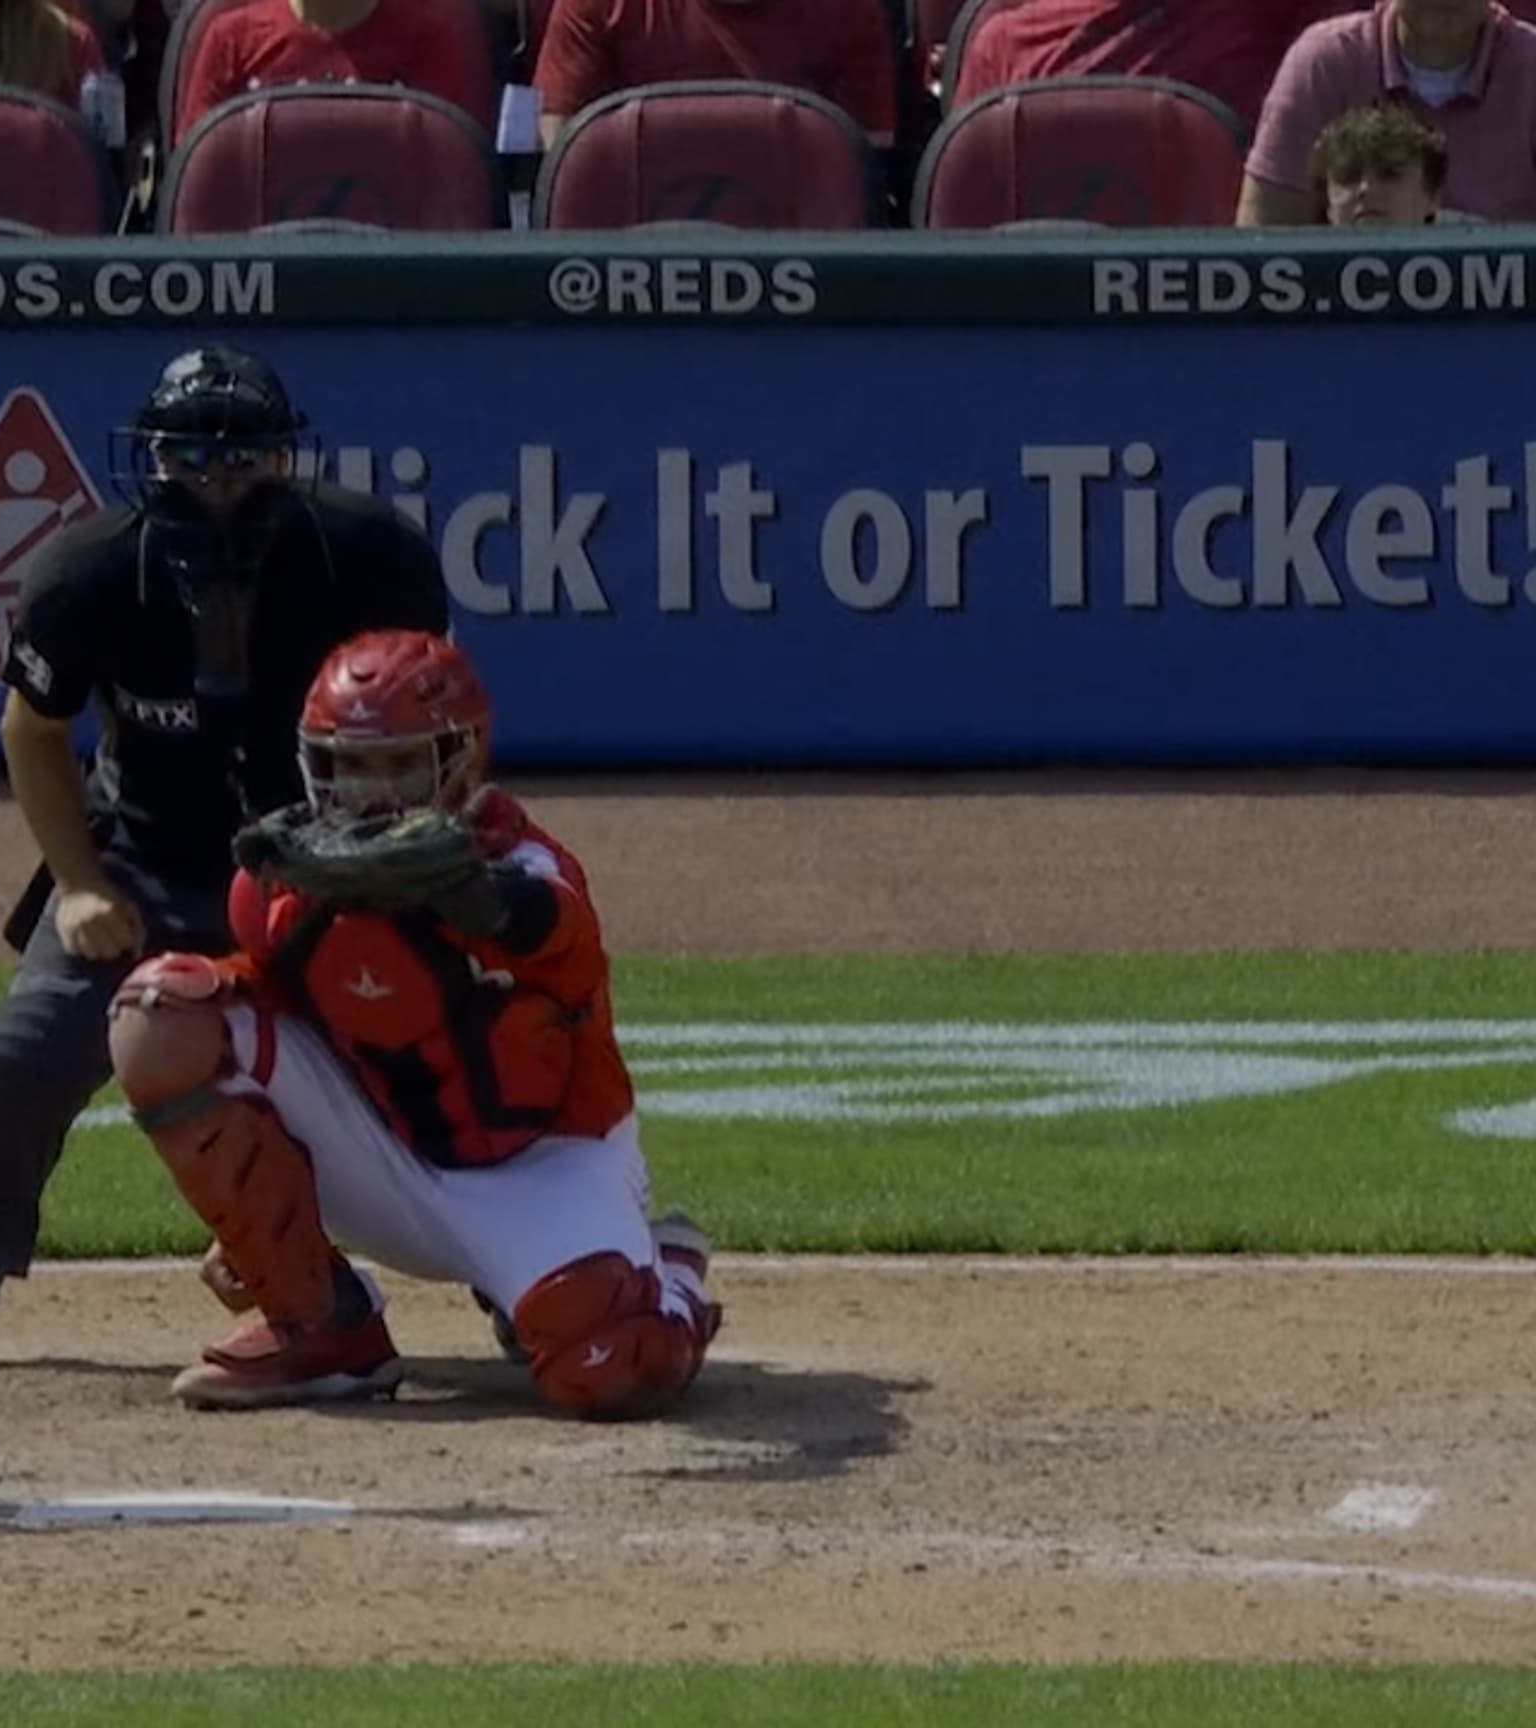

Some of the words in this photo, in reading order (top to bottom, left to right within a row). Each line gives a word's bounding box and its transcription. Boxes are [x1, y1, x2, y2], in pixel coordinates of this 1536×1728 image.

[549, 258, 816, 314] @REDS
[1092, 254, 1526, 313] REDS.COM
[289, 443, 610, 615] ick
[657, 448, 776, 612] It
[820, 487, 986, 610] or
